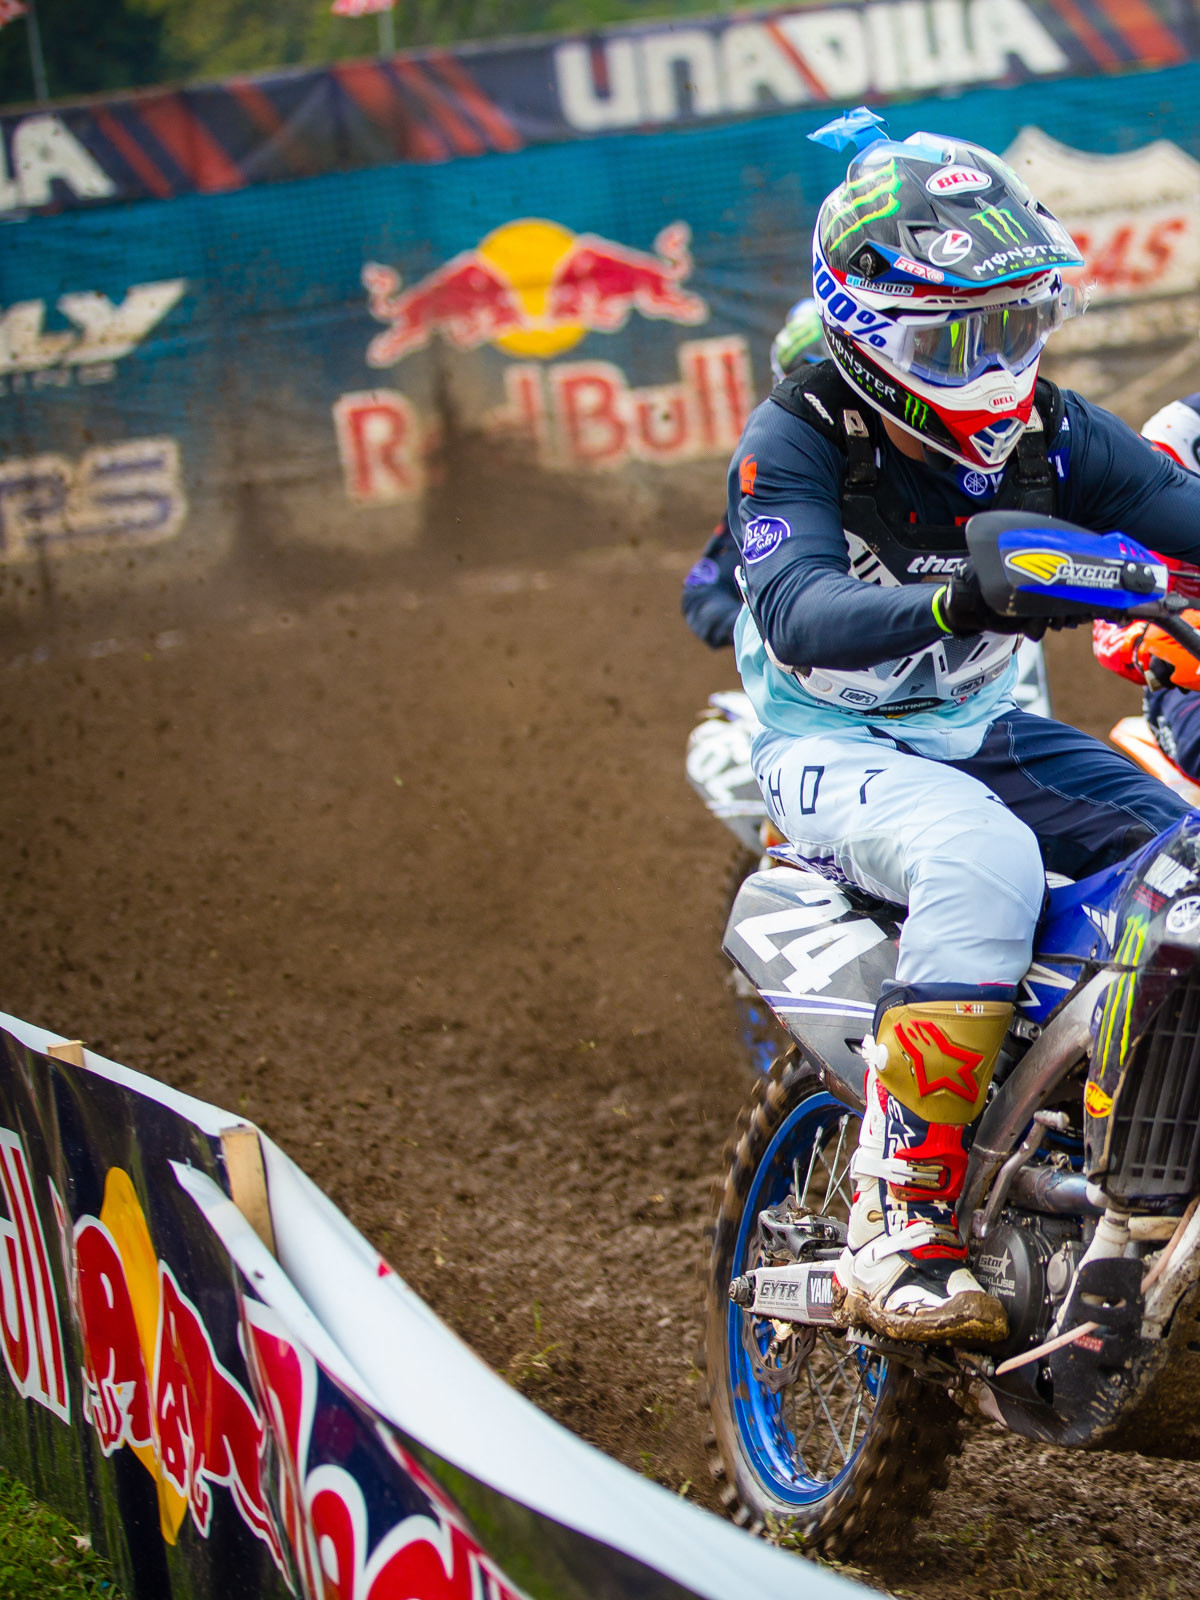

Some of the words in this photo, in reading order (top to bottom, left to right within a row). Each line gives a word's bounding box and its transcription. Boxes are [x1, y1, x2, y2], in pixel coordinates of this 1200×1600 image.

[936, 172, 983, 189] BELL
[973, 244, 1078, 276] MONSTER
[997, 255, 1068, 276] ENERGY
[826, 325, 897, 403] MONSTER
[548, 335, 755, 472] Bull
[992, 393, 1015, 407] BELL
[906, 554, 966, 574] tho
[1057, 562, 1122, 585] CYCRA
[846, 690, 872, 704] 100%
[878, 700, 935, 712] SENTINEL
[733, 889, 889, 994] 24
[955, 1003, 984, 1014] LXIII
[760, 1279, 800, 1300] GYTR
[810, 1277, 835, 1304] YAM
